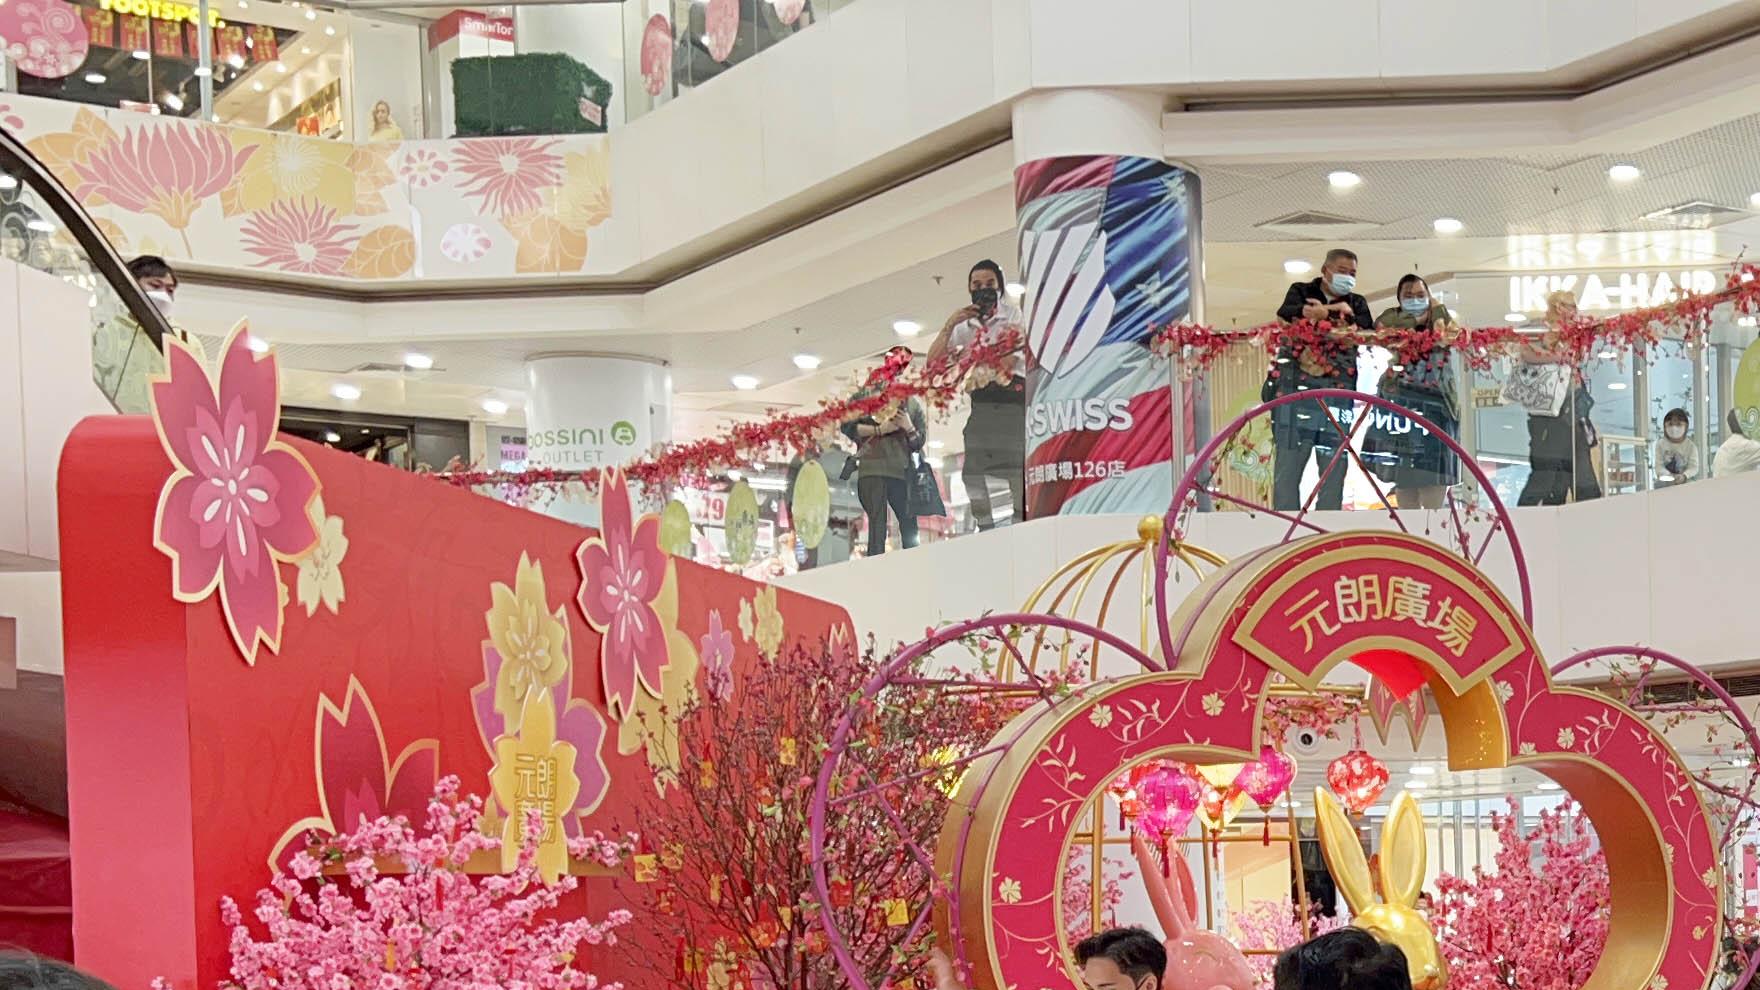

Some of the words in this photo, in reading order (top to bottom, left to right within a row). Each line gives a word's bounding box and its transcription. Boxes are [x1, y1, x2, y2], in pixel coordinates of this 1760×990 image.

[543, 451, 603, 464] OUTLET
[1284, 574, 1478, 657] 元朗廣場
